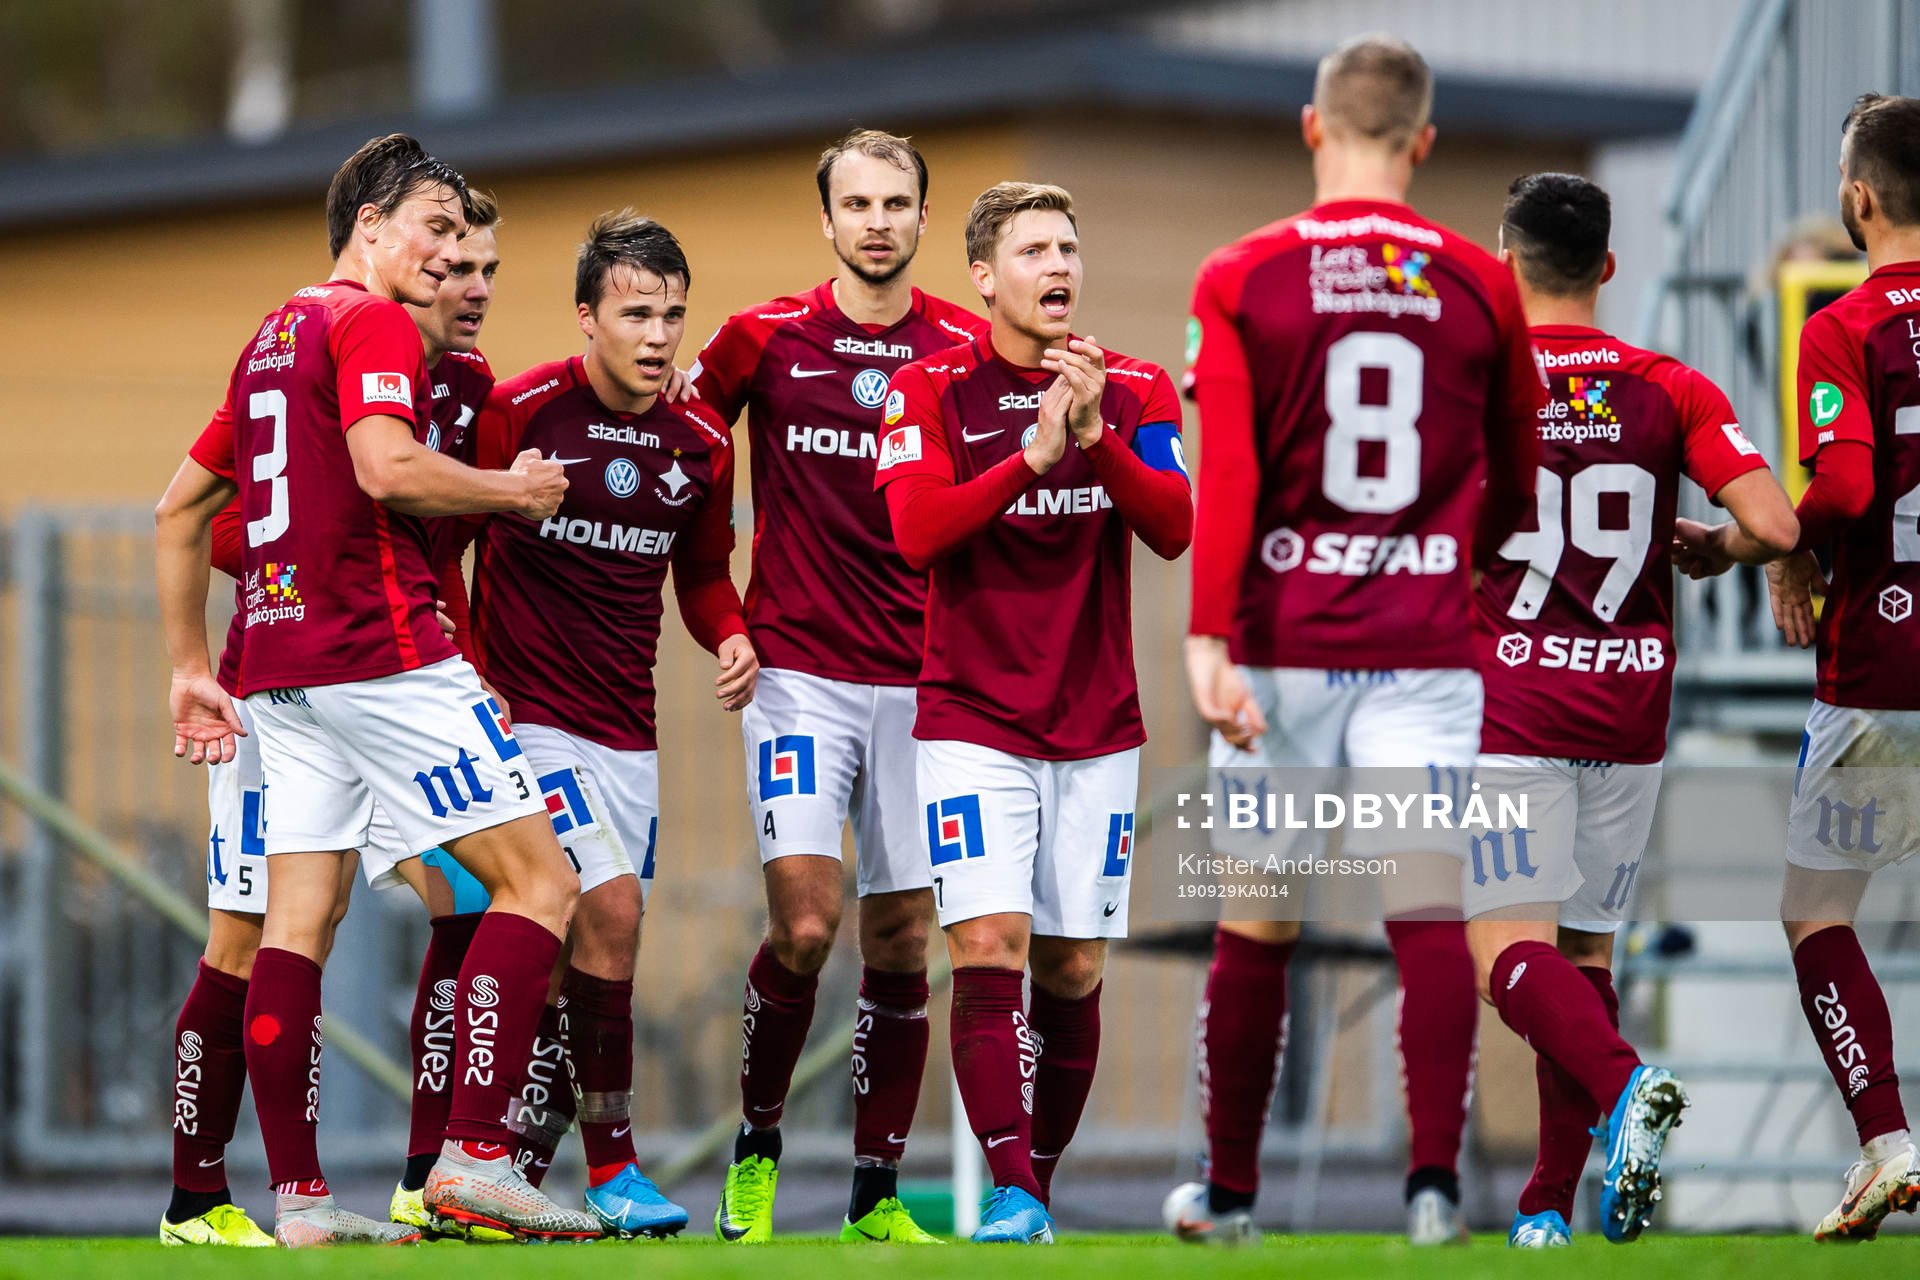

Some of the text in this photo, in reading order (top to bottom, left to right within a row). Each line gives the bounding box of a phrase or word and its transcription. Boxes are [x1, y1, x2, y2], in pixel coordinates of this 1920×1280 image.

[833, 336, 913, 359] stadium
[587, 422, 660, 449] stadium
[1325, 331, 1424, 513] 8
[247, 389, 290, 548] 3
[1004, 485, 1114, 516] LMEN
[539, 516, 677, 555] HOLMEN
[1538, 636, 1665, 673] SEFAB
[508, 770, 531, 800] 3
[763, 810, 777, 840] 4
[239, 865, 253, 896] 5
